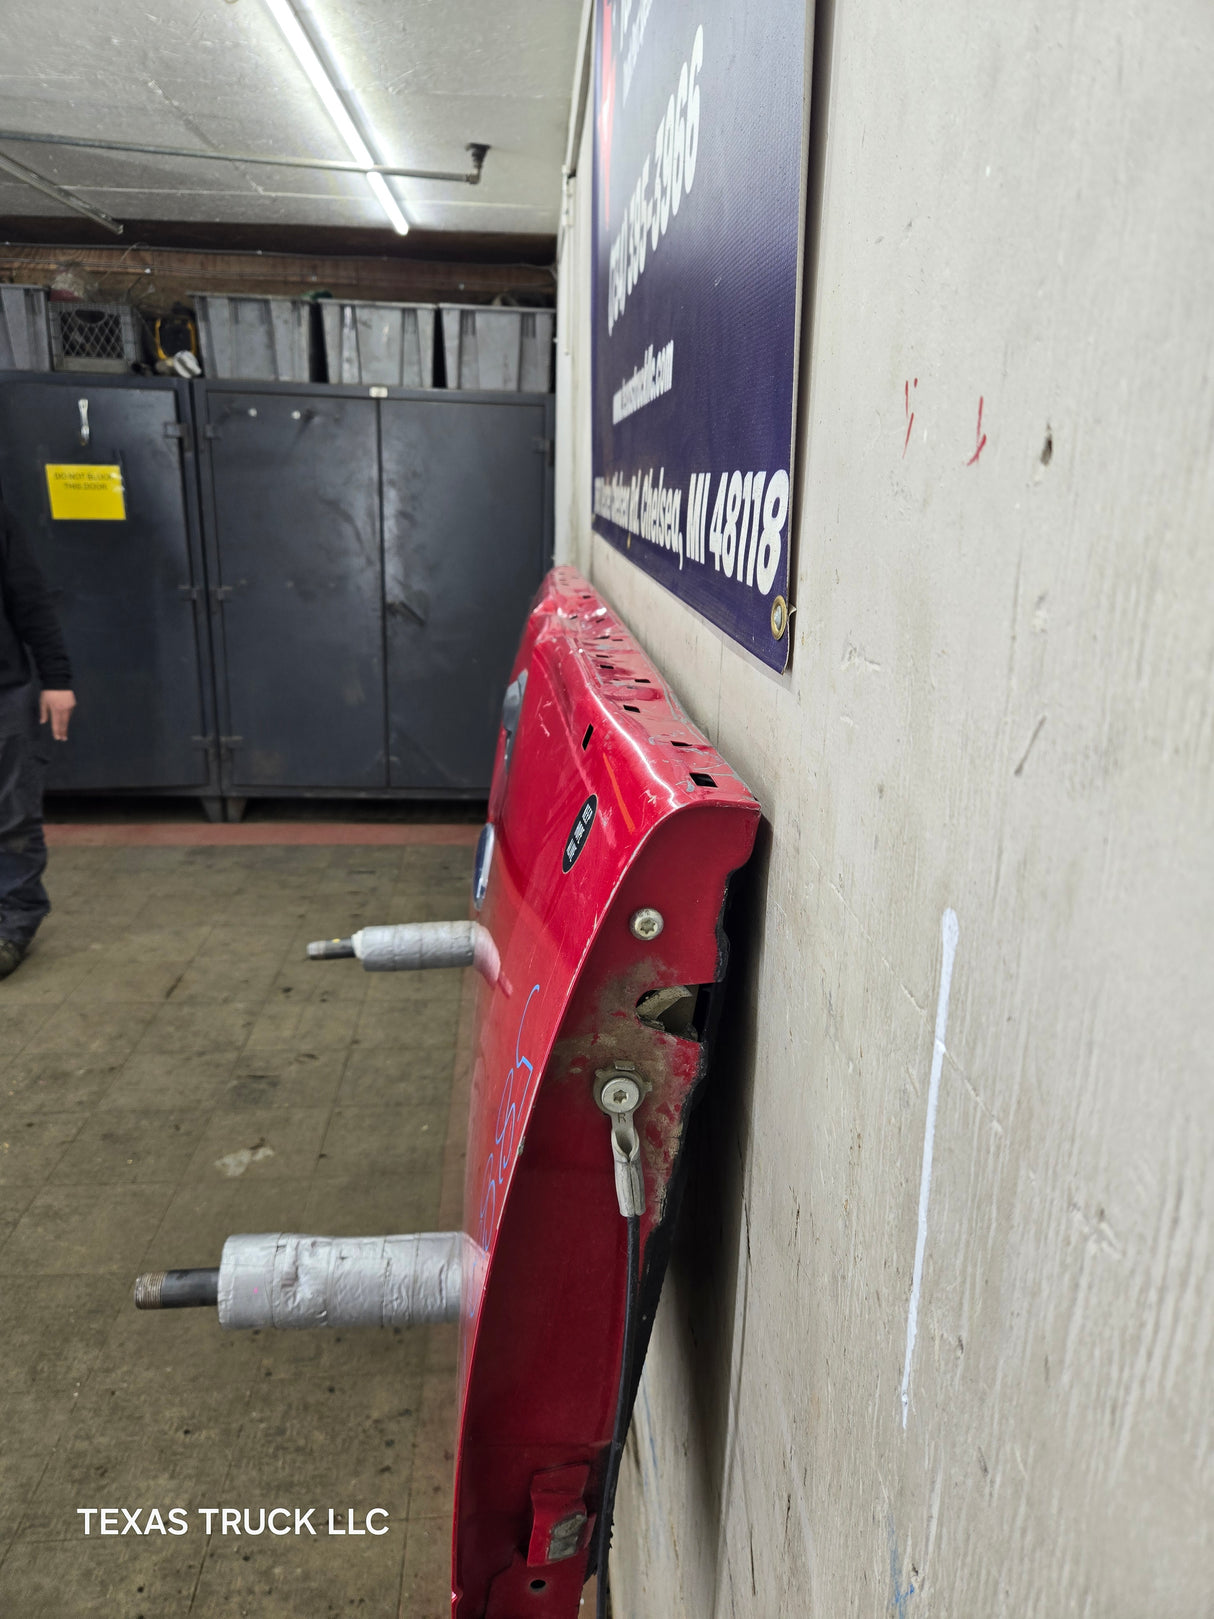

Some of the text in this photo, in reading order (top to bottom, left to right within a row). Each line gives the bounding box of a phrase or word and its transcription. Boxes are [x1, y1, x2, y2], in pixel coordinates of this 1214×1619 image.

[641, 467, 683, 570] Chelsea,
[686, 473, 711, 564] MI
[709, 470, 789, 595] 48118
